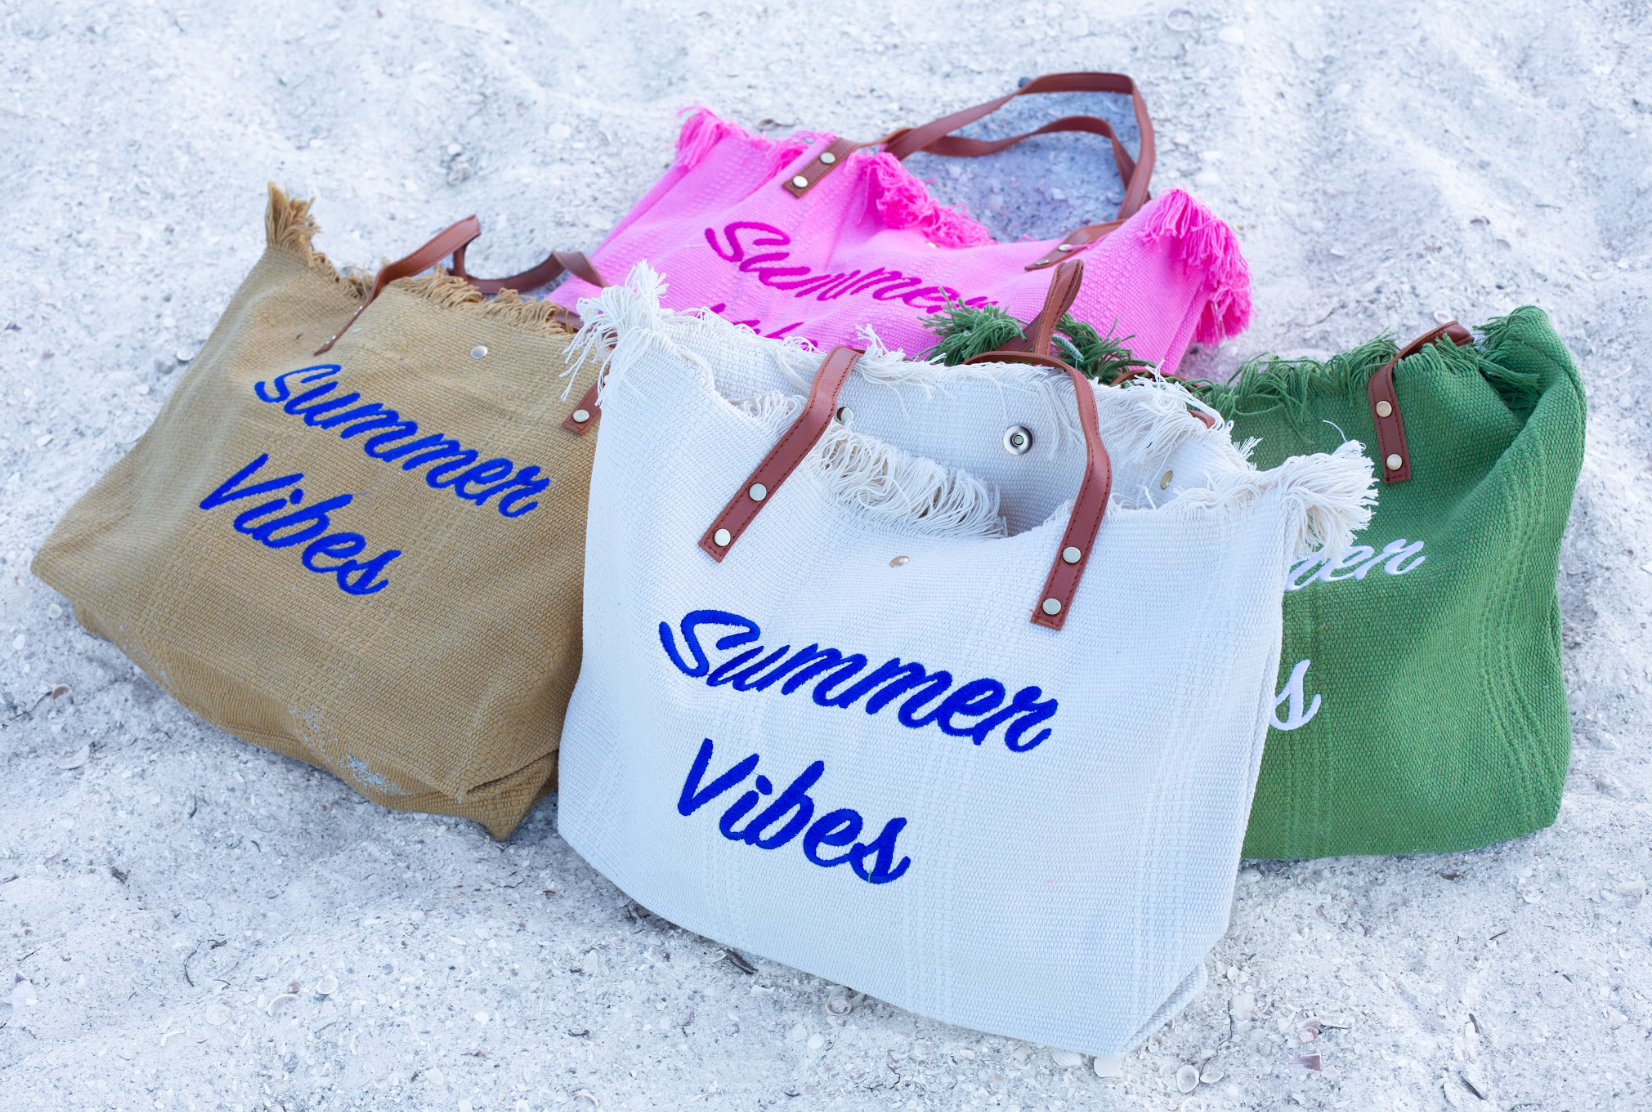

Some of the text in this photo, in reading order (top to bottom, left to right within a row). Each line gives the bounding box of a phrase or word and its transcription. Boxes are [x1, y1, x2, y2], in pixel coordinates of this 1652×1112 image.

[255, 363, 551, 518] Summer
[200, 453, 402, 596] Vibes
[658, 609, 1059, 753] Summer
[677, 737, 912, 885] Vibes
